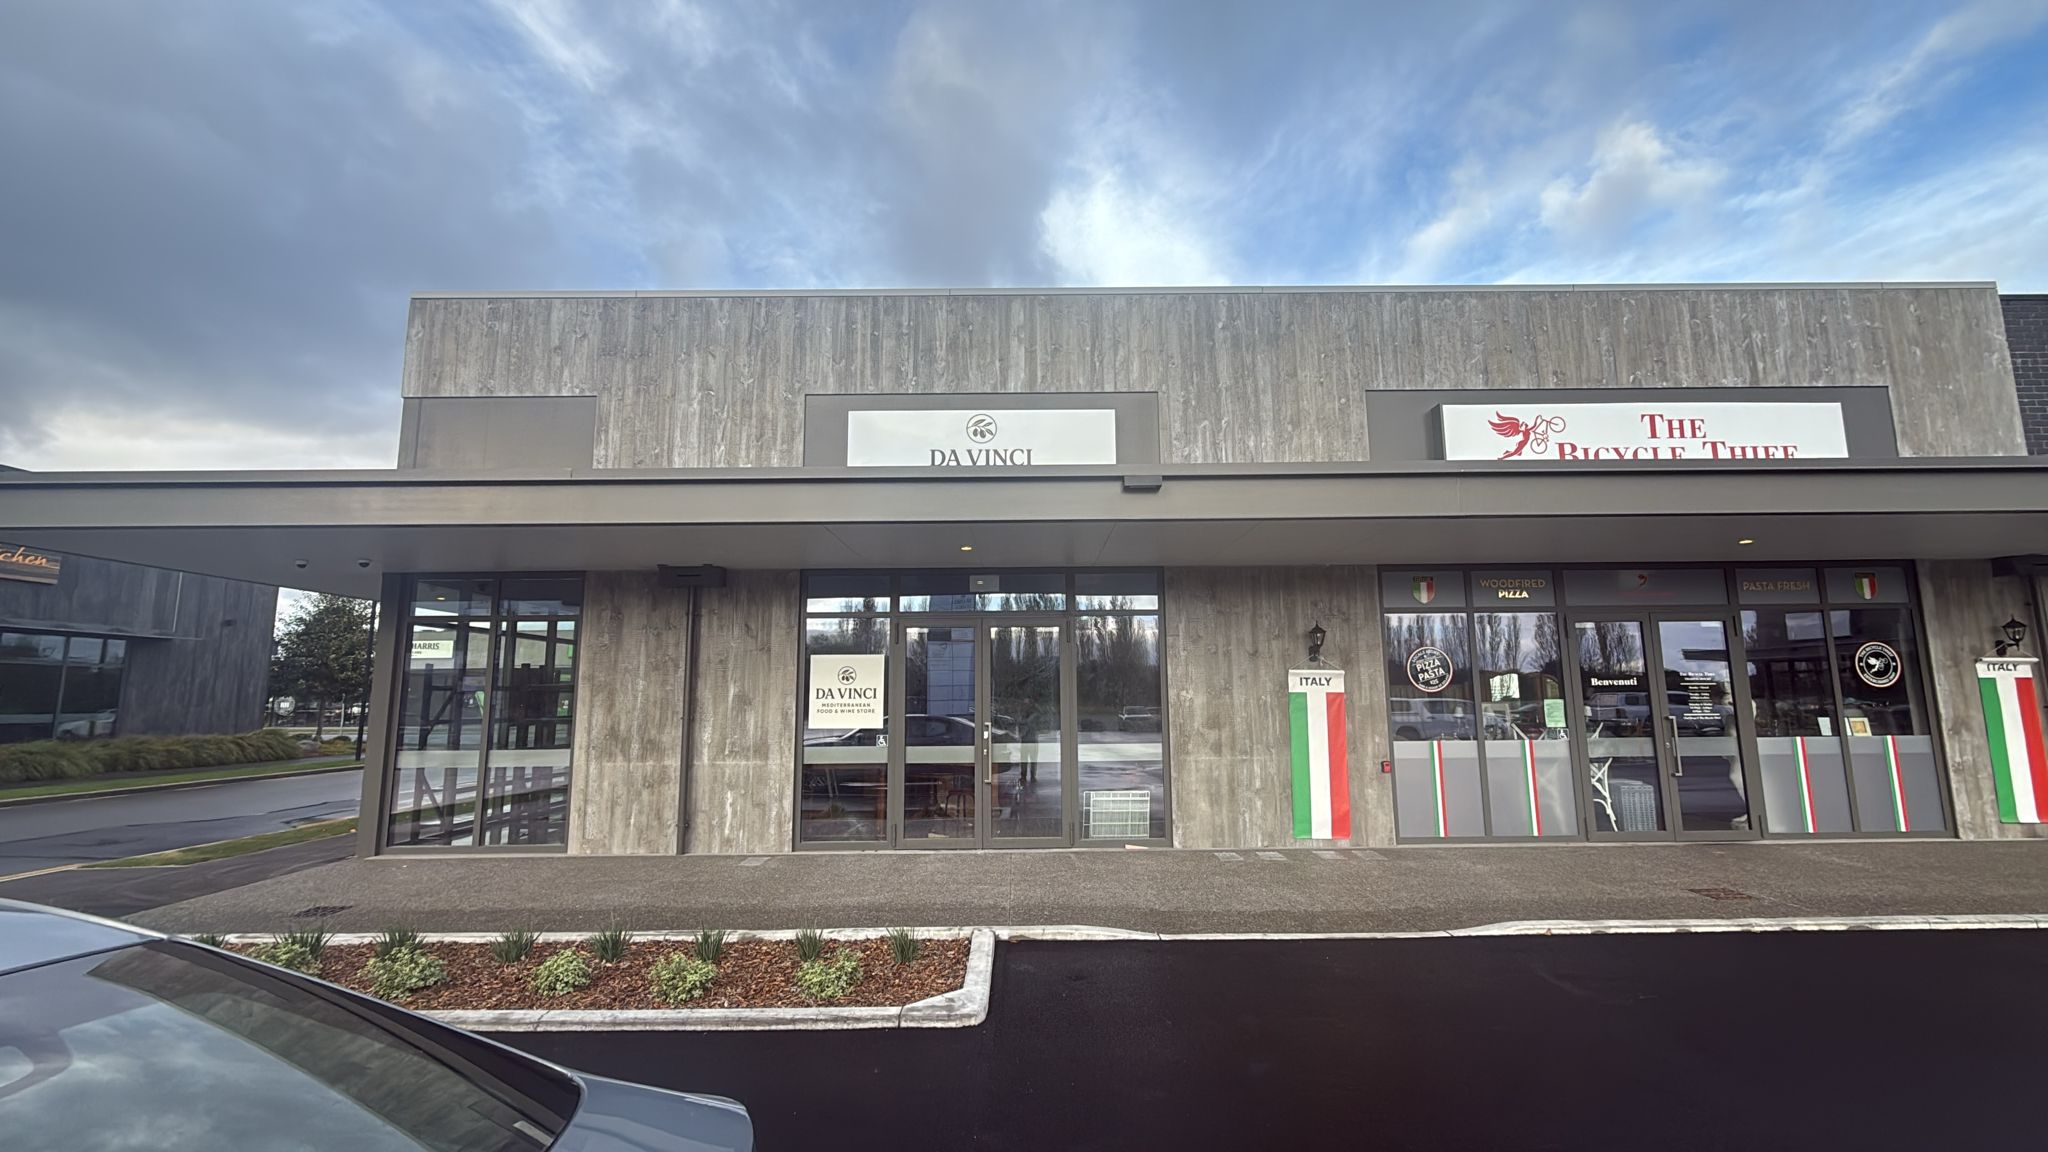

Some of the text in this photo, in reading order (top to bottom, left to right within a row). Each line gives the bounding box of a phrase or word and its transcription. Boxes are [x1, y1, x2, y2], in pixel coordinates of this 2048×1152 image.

[1640, 413, 1706, 439] THE
[930, 449, 1032, 466] DA VINCI
[1480, 579, 1546, 588] WOODFIRED
[1743, 581, 1810, 591] PASTA FRESH
[1498, 589, 1529, 599] PIZZA
[1416, 658, 1441, 672] PIZZA
[1986, 662, 2020, 671] ITALY
[1418, 667, 1446, 682] PASTA
[1299, 676, 1332, 686] ITALY
[1590, 677, 1638, 686] Benvenuti
[815, 687, 877, 700] DA VINCI
